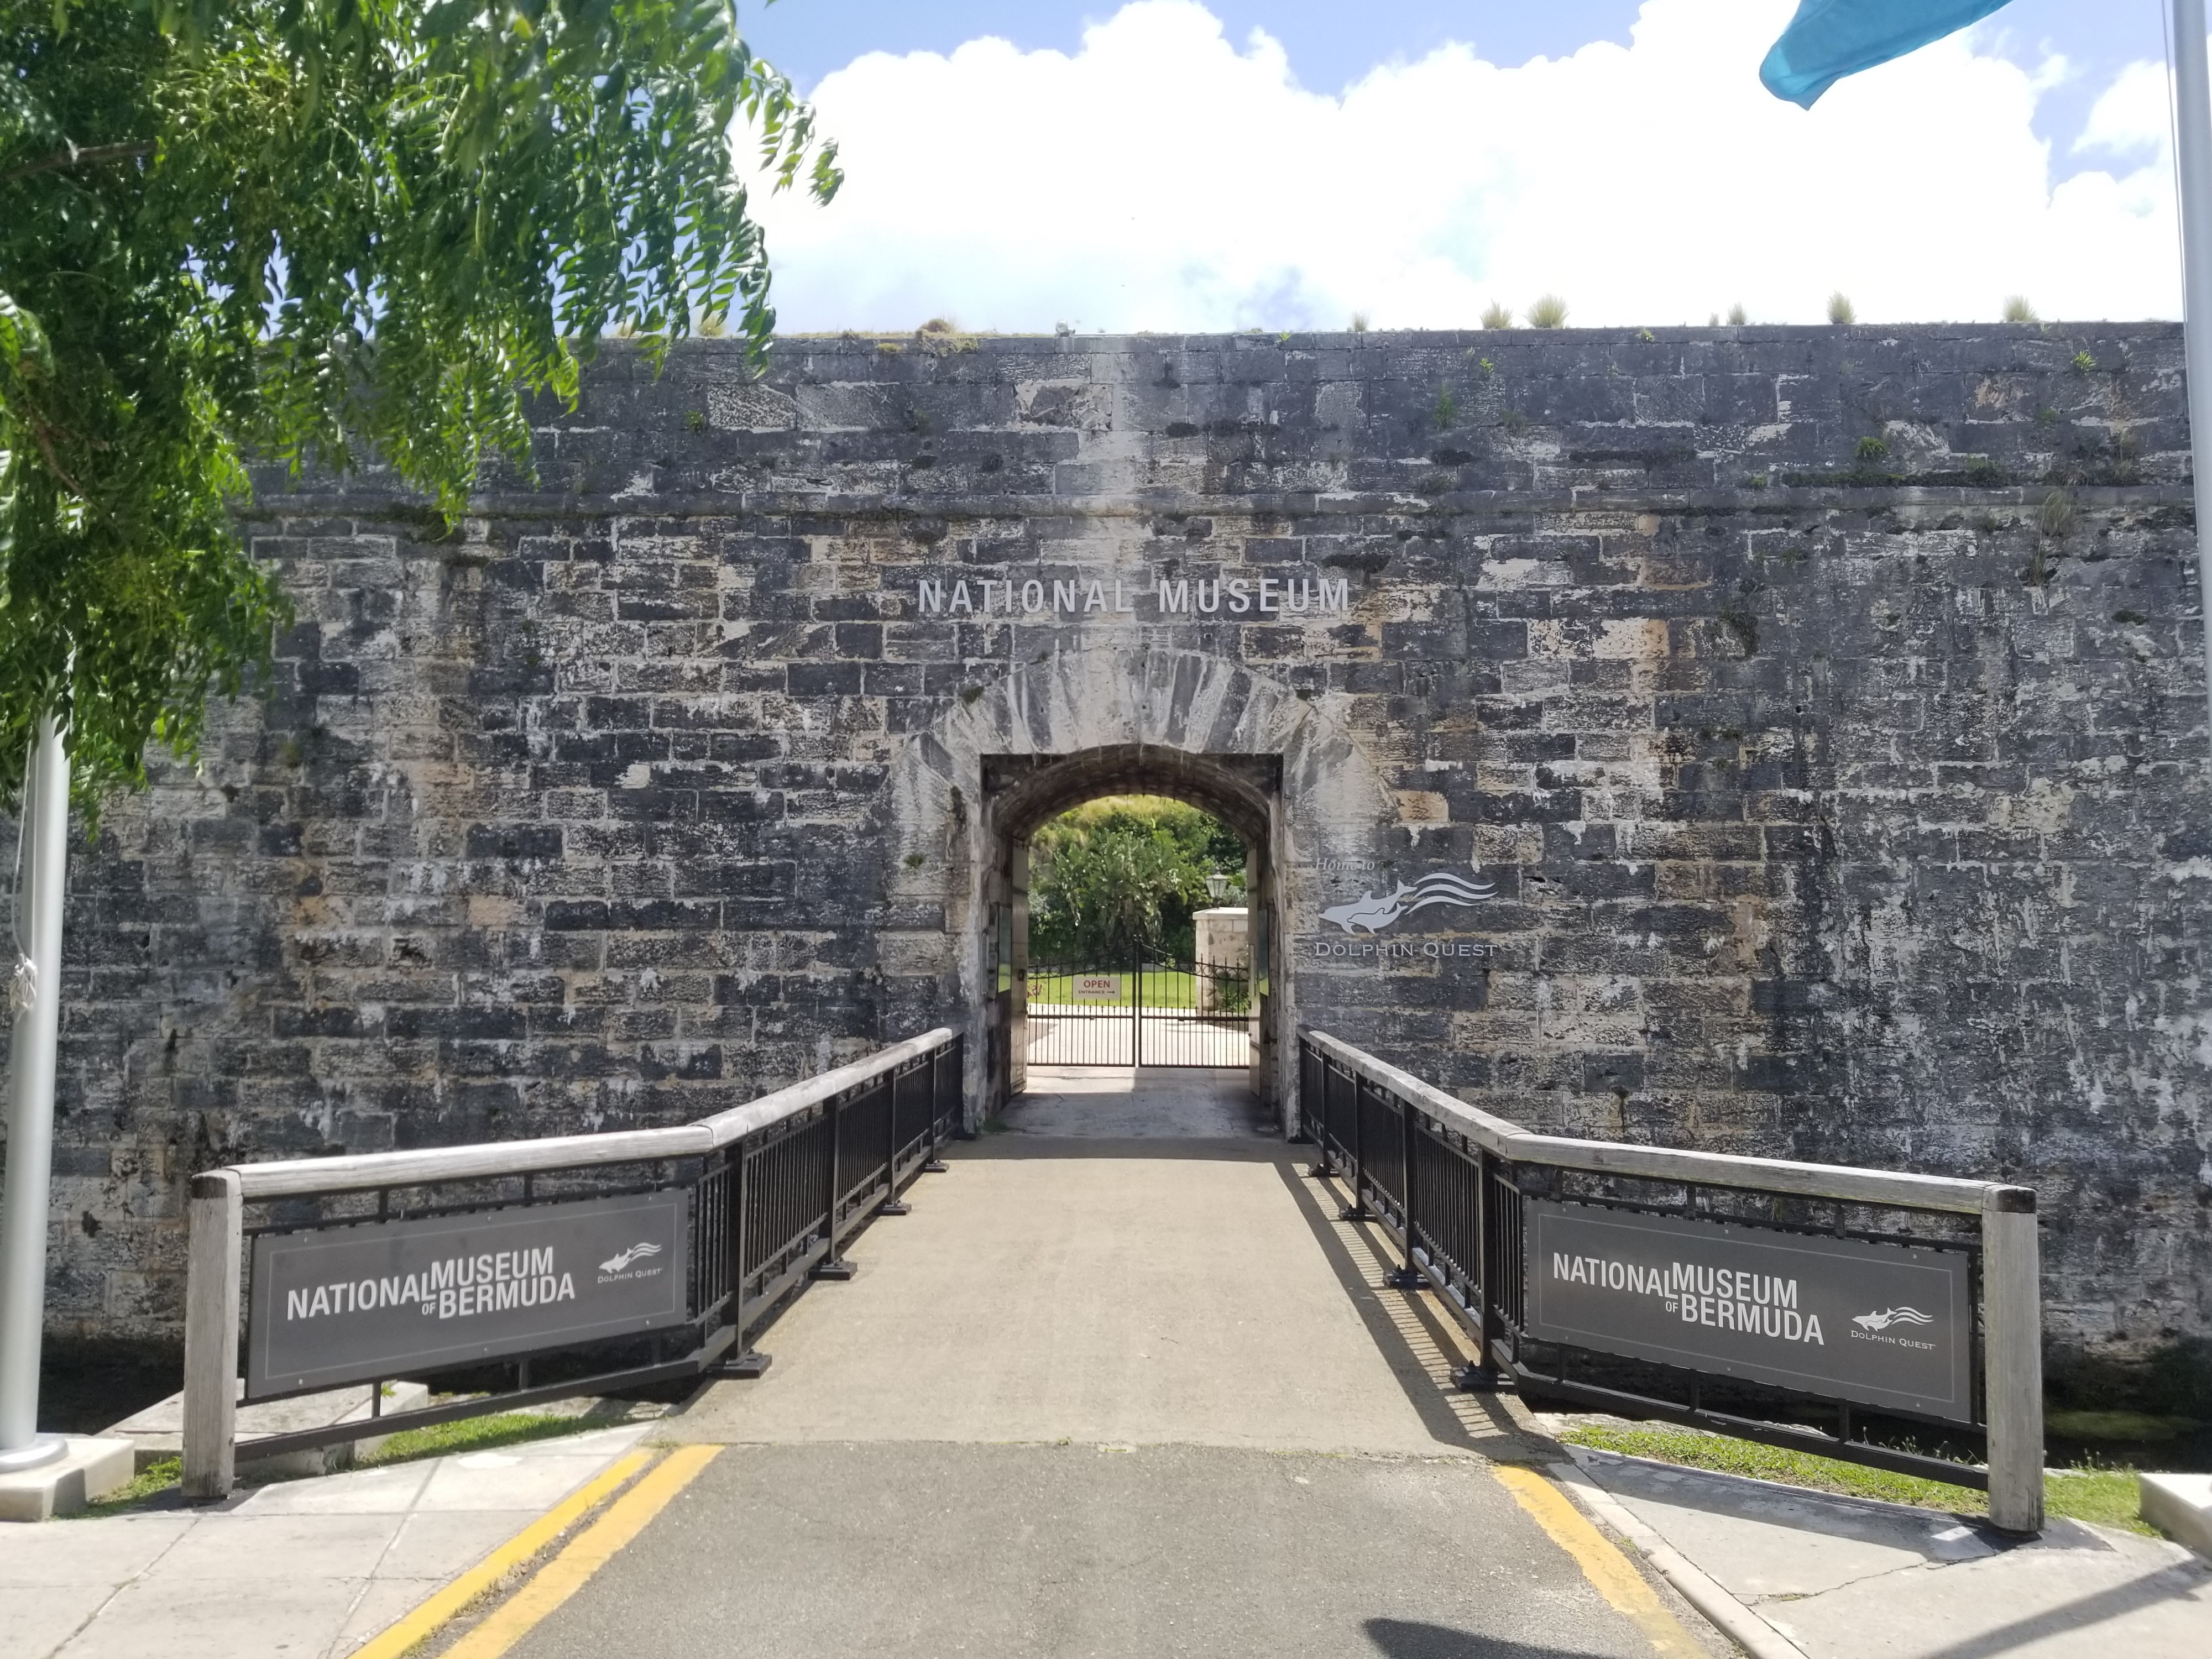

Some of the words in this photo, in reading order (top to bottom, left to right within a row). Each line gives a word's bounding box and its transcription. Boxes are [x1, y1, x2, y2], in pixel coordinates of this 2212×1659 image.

[919, 579, 1134, 613] NATIONAL
[1159, 578, 1348, 613] MUSEUM
[1316, 857, 1357, 871] Home
[1362, 860, 1375, 871] to
[1315, 942, 1414, 956] DOLPHIN
[1423, 942, 1498, 958] QUEST
[1084, 980, 1110, 988] OPEN
[287, 1272, 437, 1321] NATIONAL
[431, 1246, 553, 1290] MUSEUM
[598, 1272, 632, 1283] DOLPHIN
[635, 1268, 662, 1278] QUEST
[1553, 1252, 1678, 1300] NATIONAL
[1672, 1262, 1797, 1310] MUSEUM
[421, 1302, 436, 1315] OF
[439, 1273, 576, 1320] BERMUDA
[1665, 1301, 1678, 1313] OF
[1681, 1293, 1824, 1346] BERMUDA
[1851, 1330, 1896, 1344] DOLPHIN
[1899, 1338, 1936, 1350] QUEST
